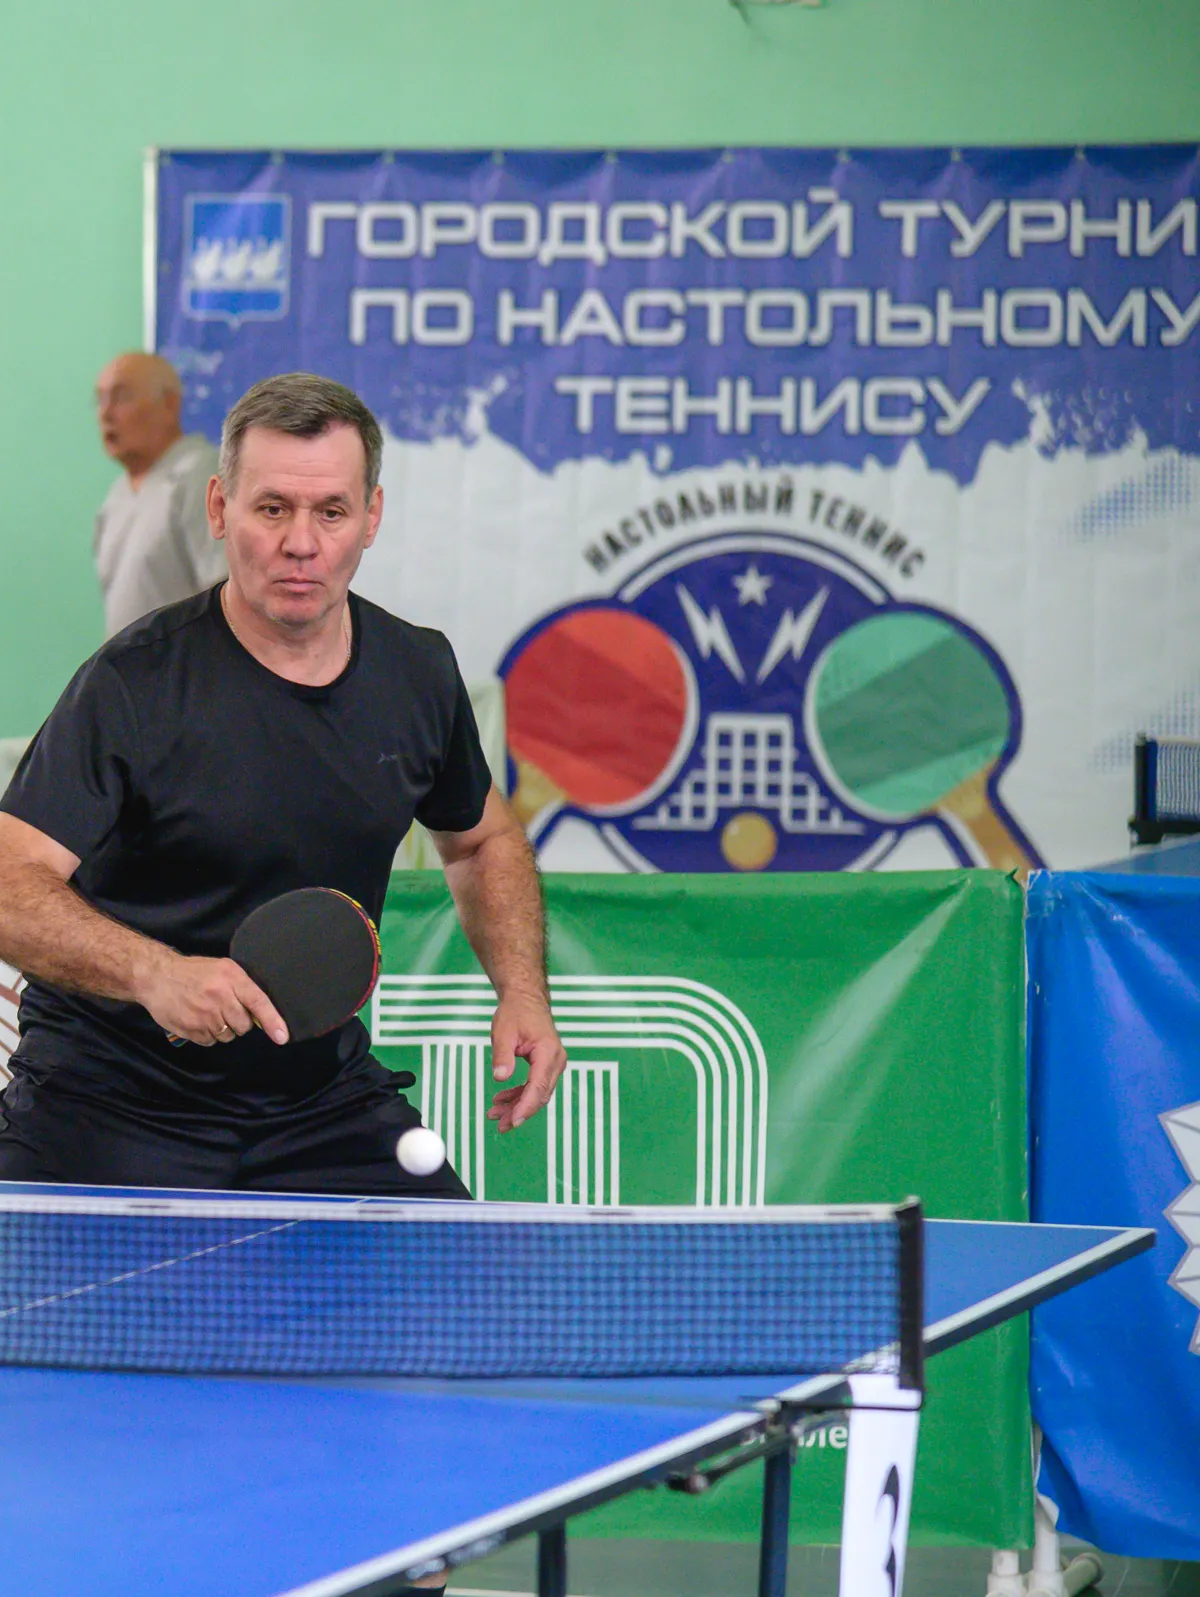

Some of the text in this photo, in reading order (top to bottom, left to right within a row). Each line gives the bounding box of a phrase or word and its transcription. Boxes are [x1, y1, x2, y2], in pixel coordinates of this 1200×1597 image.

[307, 186, 1198, 266] ГОРОДСКОЙ ТУРНИ
[349, 286, 1200, 347] ПО НАСТОЛЬНОМУ
[554, 375, 992, 436] ТЕННИСУ
[582, 474, 926, 579] НАСТОЛЬНЫЙ ТЕННИС
